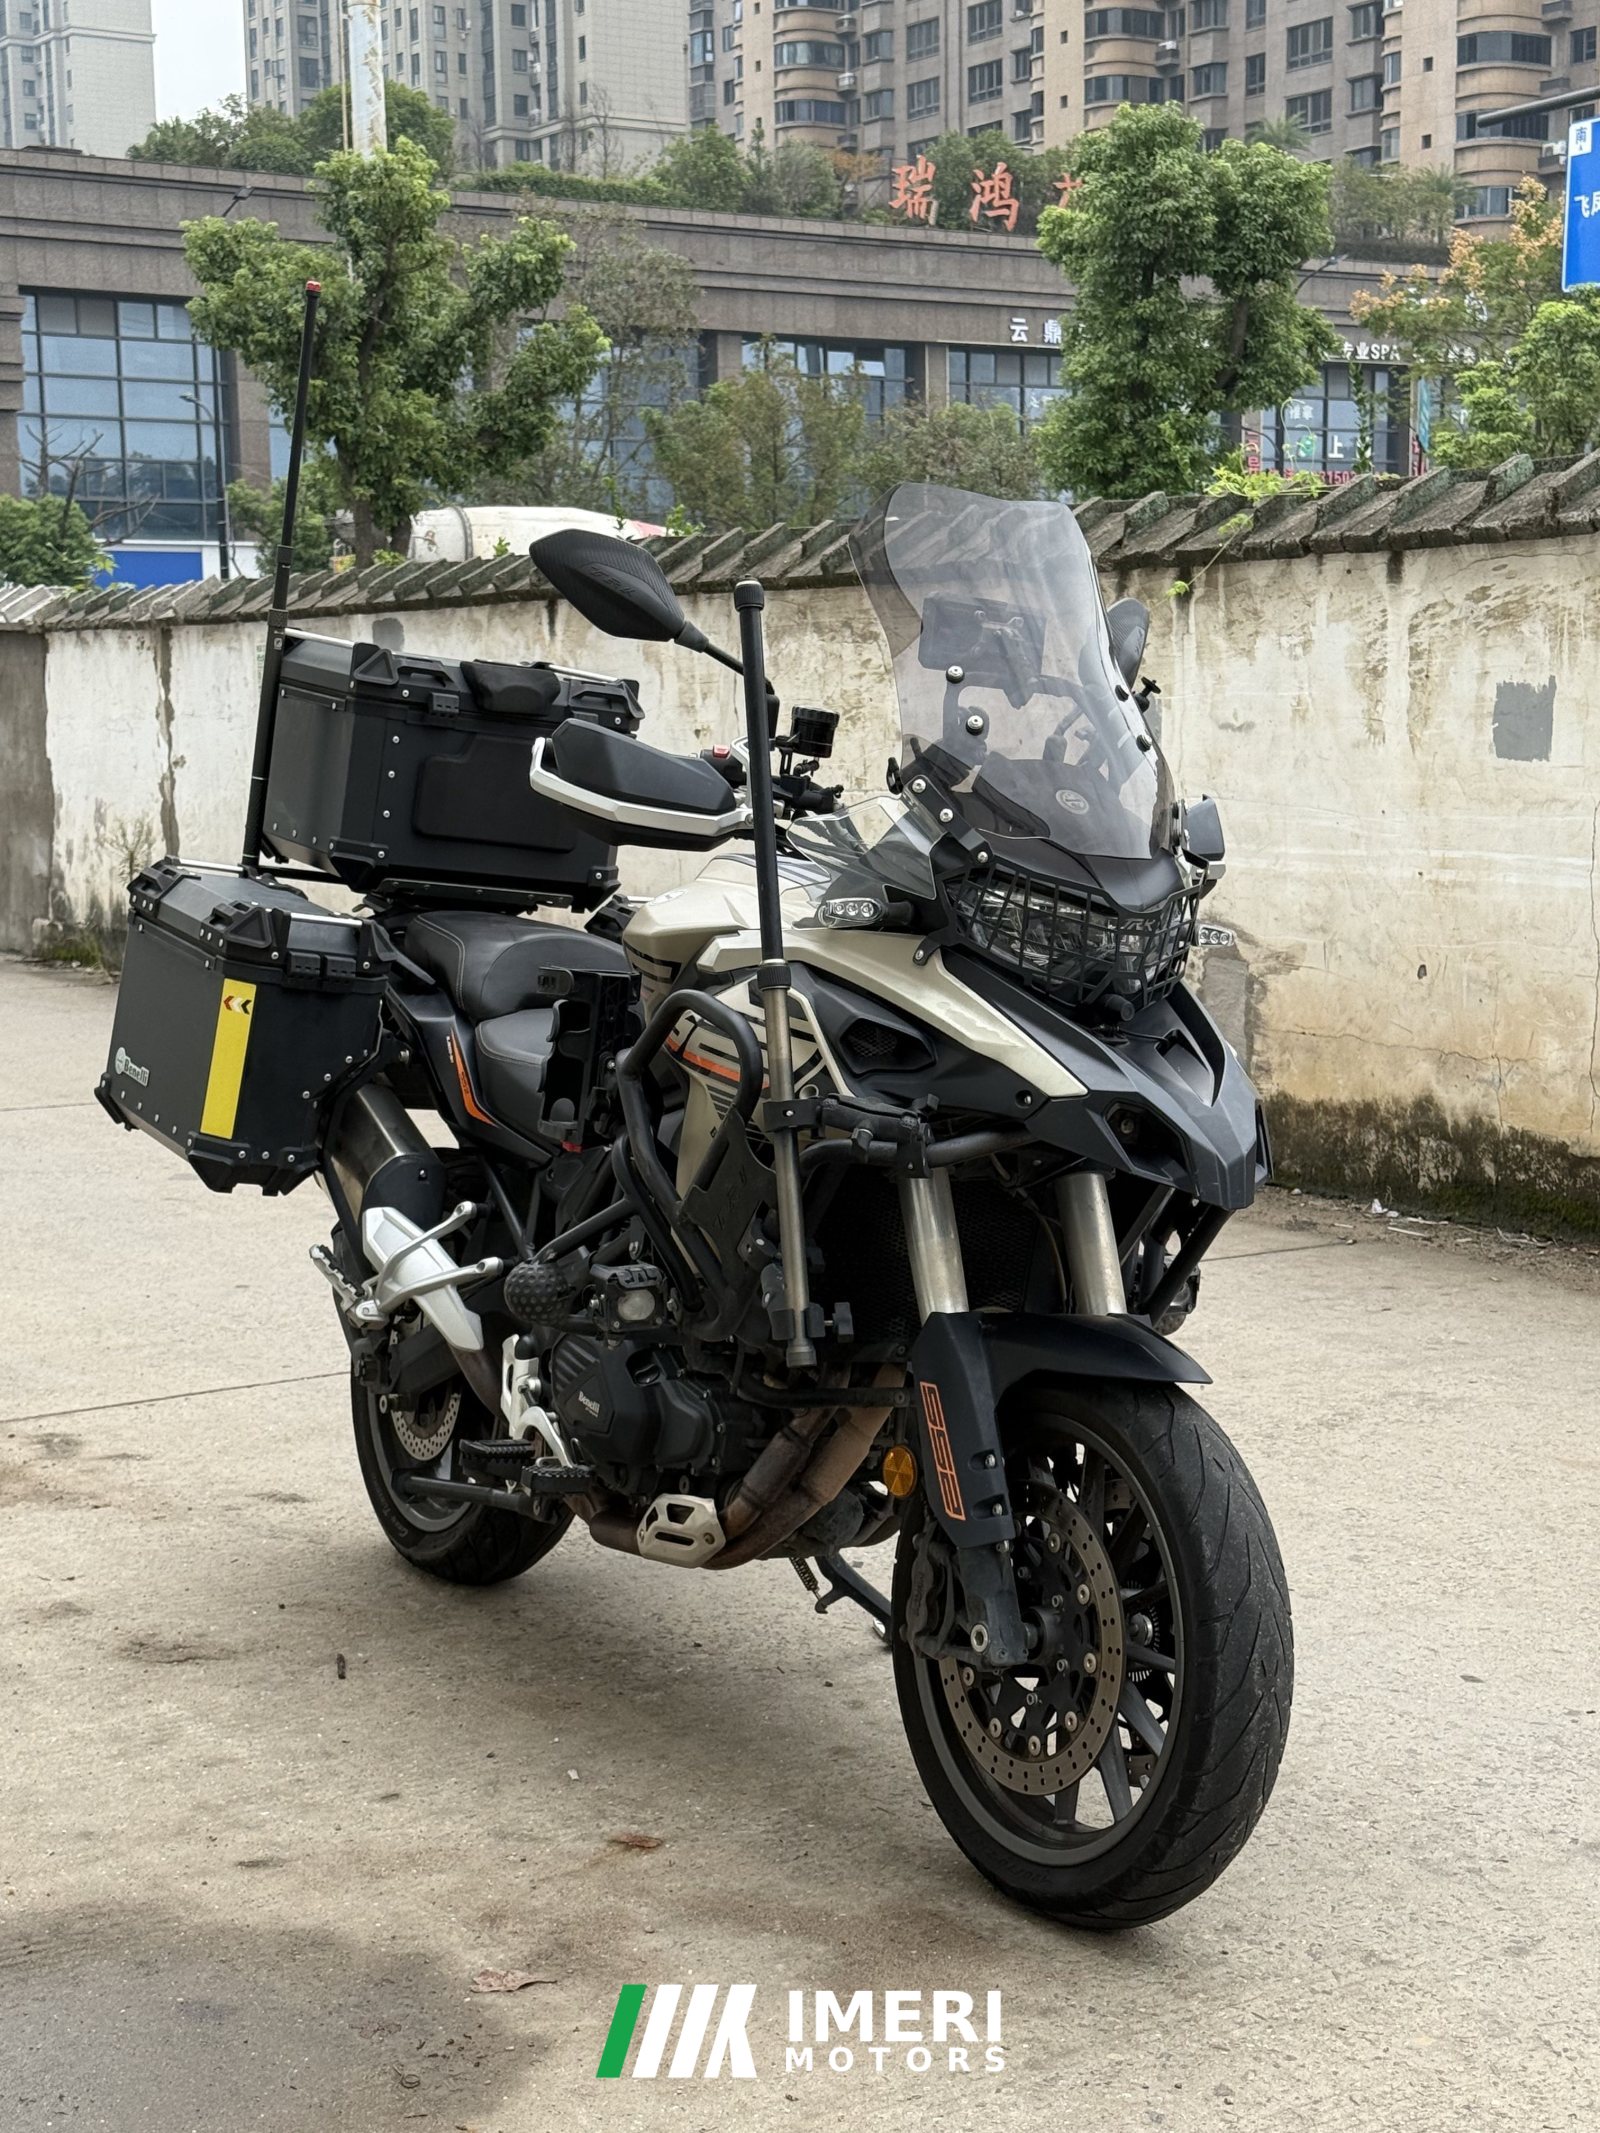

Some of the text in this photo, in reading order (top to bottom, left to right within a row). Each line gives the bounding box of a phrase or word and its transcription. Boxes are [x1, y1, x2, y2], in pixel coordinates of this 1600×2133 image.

[1575, 127, 1588, 145] 南
[1120, 918, 1156, 932] TRK
[124, 1057, 148, 1085] Benelli
[578, 1390, 600, 1414] Benelli
